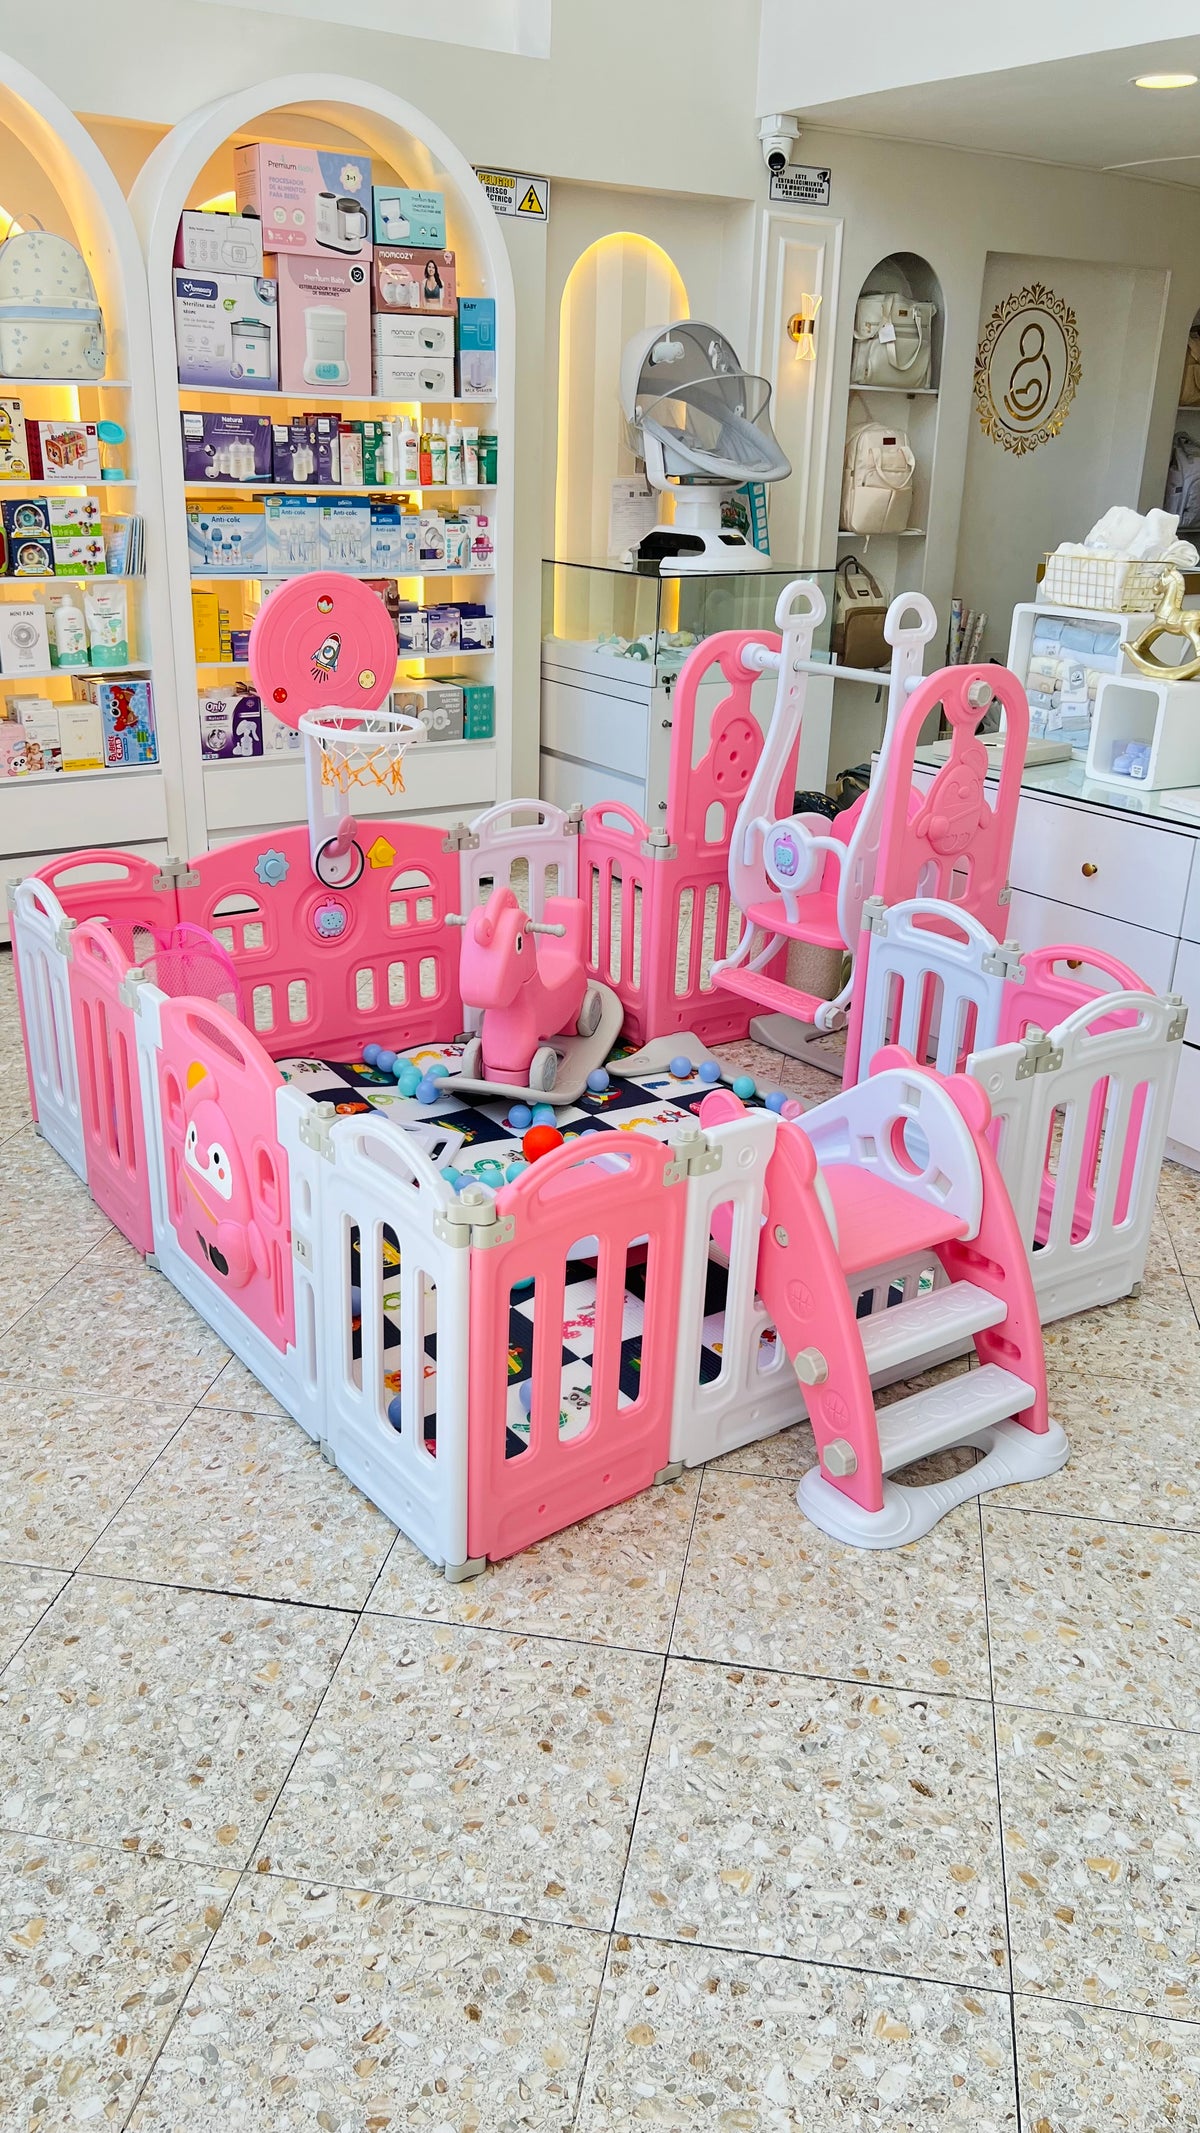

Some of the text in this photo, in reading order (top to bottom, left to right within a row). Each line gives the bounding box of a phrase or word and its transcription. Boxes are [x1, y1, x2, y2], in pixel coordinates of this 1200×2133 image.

[268, 160, 297, 170] Premium
[268, 176, 304, 186] PROCESADOR
[478, 173, 516, 189] PELIGRO
[777, 177, 824, 188] ESTABLECIMIENTO
[278, 184, 307, 194] ALIMENTOS
[486, 185, 508, 196] RIESGO
[788, 184, 825, 194] MONITOREADO
[304, 274, 346, 285] Premium Baby
[299, 284, 329, 292] ESTERILIZADOR
[211, 515, 241, 523] Anti-colic
[206, 701, 227, 713] Only
[115, 738, 123, 759] CRAB
